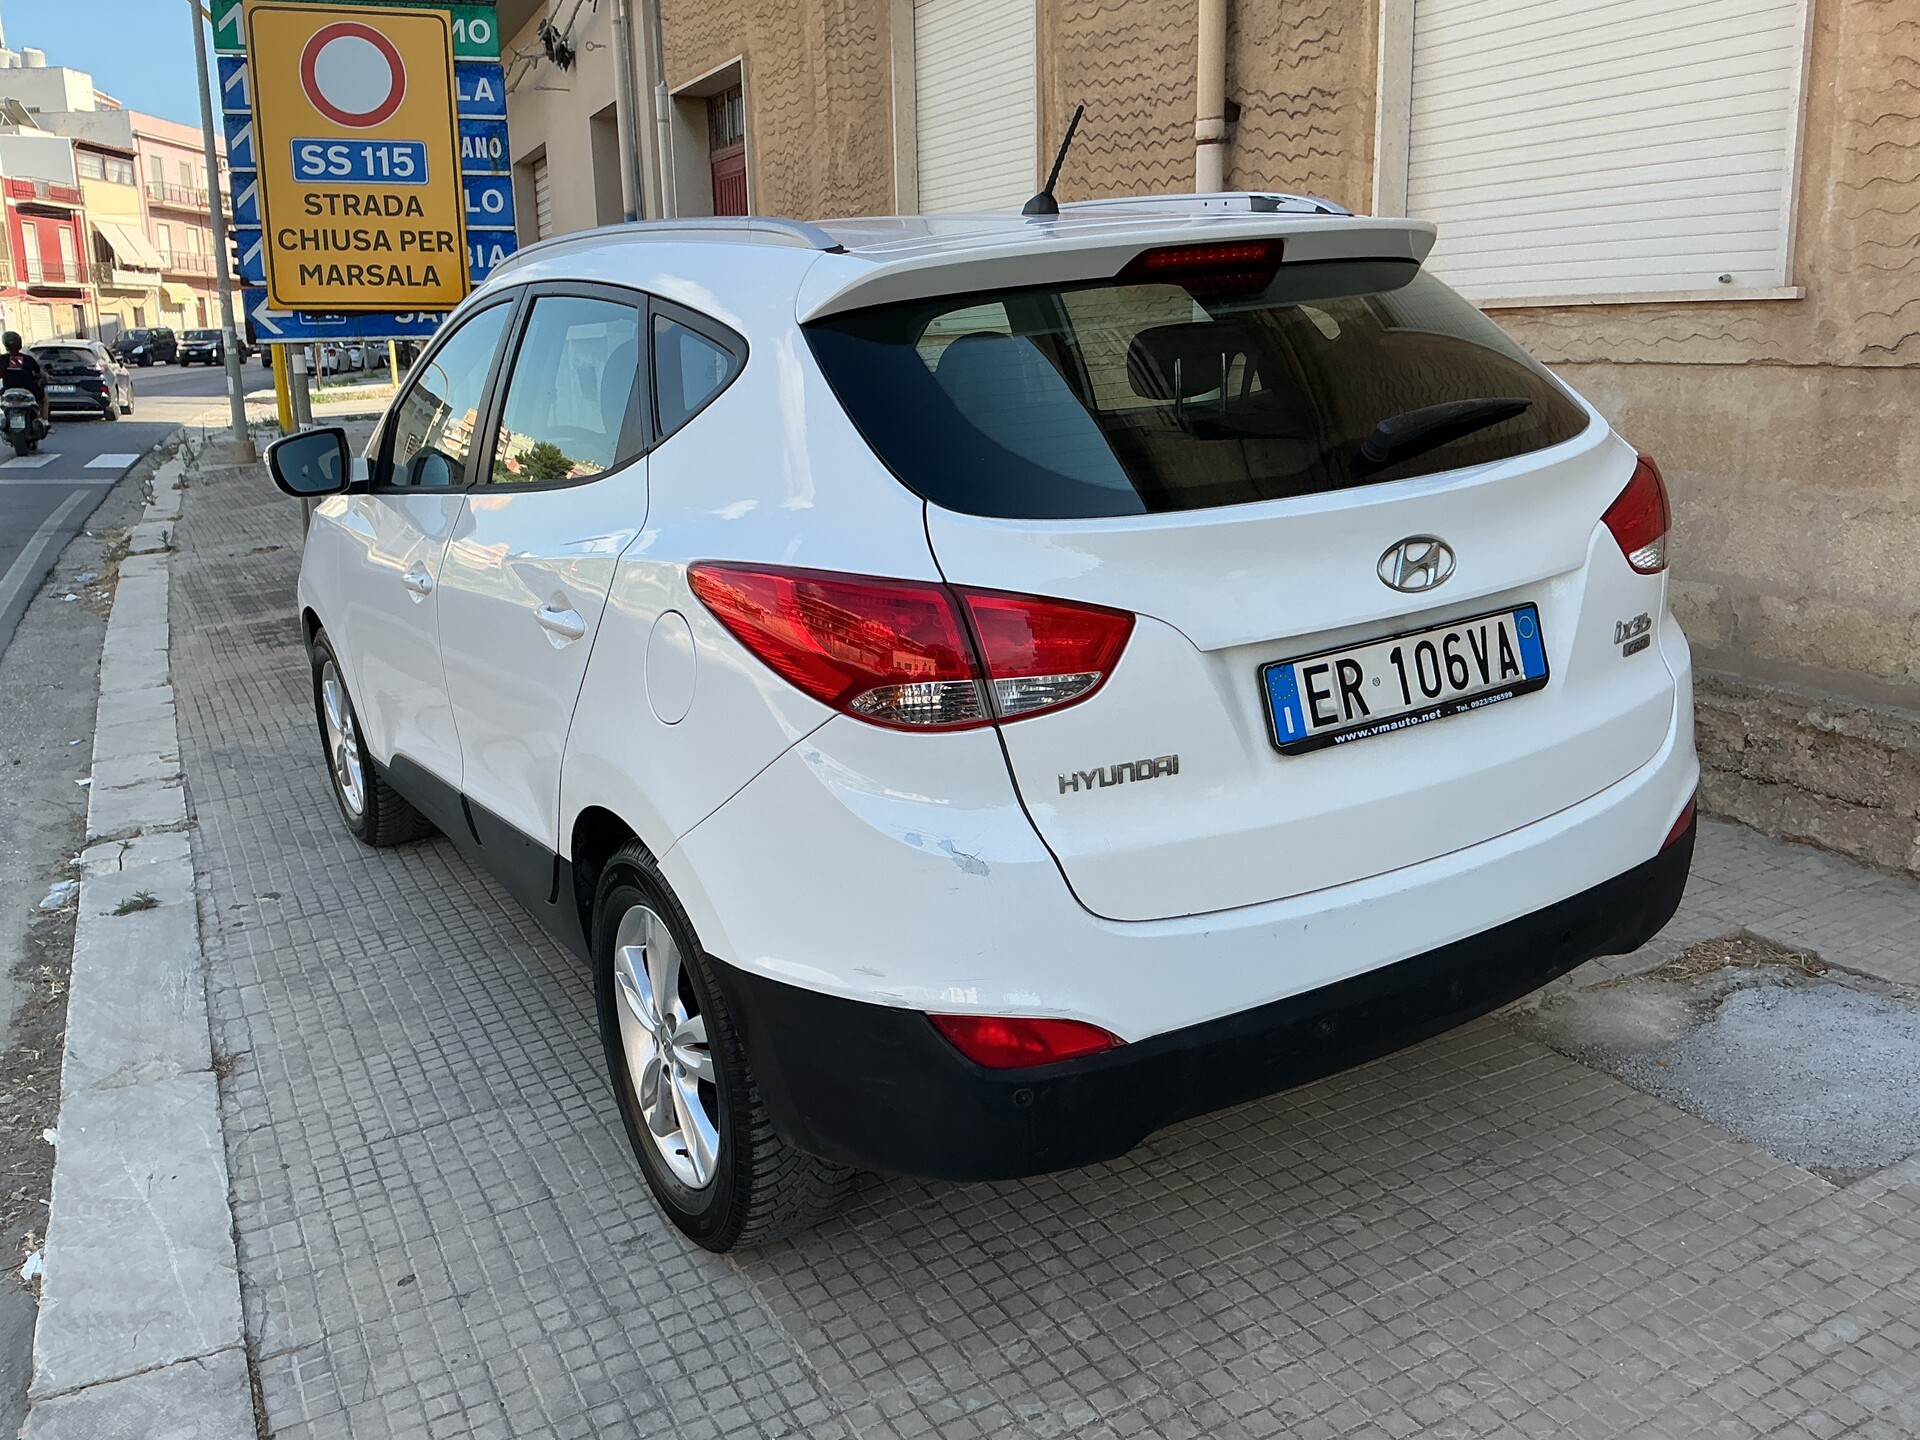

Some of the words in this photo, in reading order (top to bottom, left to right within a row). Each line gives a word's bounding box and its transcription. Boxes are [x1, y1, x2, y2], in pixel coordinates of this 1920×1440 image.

[462, 137, 502, 159] ANO
[301, 144, 352, 175] SS
[361, 146, 415, 177] 115
[304, 193, 424, 217] STRADA
[464, 189, 504, 213] LO
[277, 228, 392, 251] CHIUSA
[400, 231, 454, 252] PER
[299, 264, 441, 287] MARSALA
[1303, 658, 1370, 729] ER
[1389, 621, 1520, 706] 106VA
[1334, 709, 1442, 744] www.vmauto.net
[1456, 703, 1470, 713] Tel.
[1058, 754, 1179, 795] HYUNDAI
